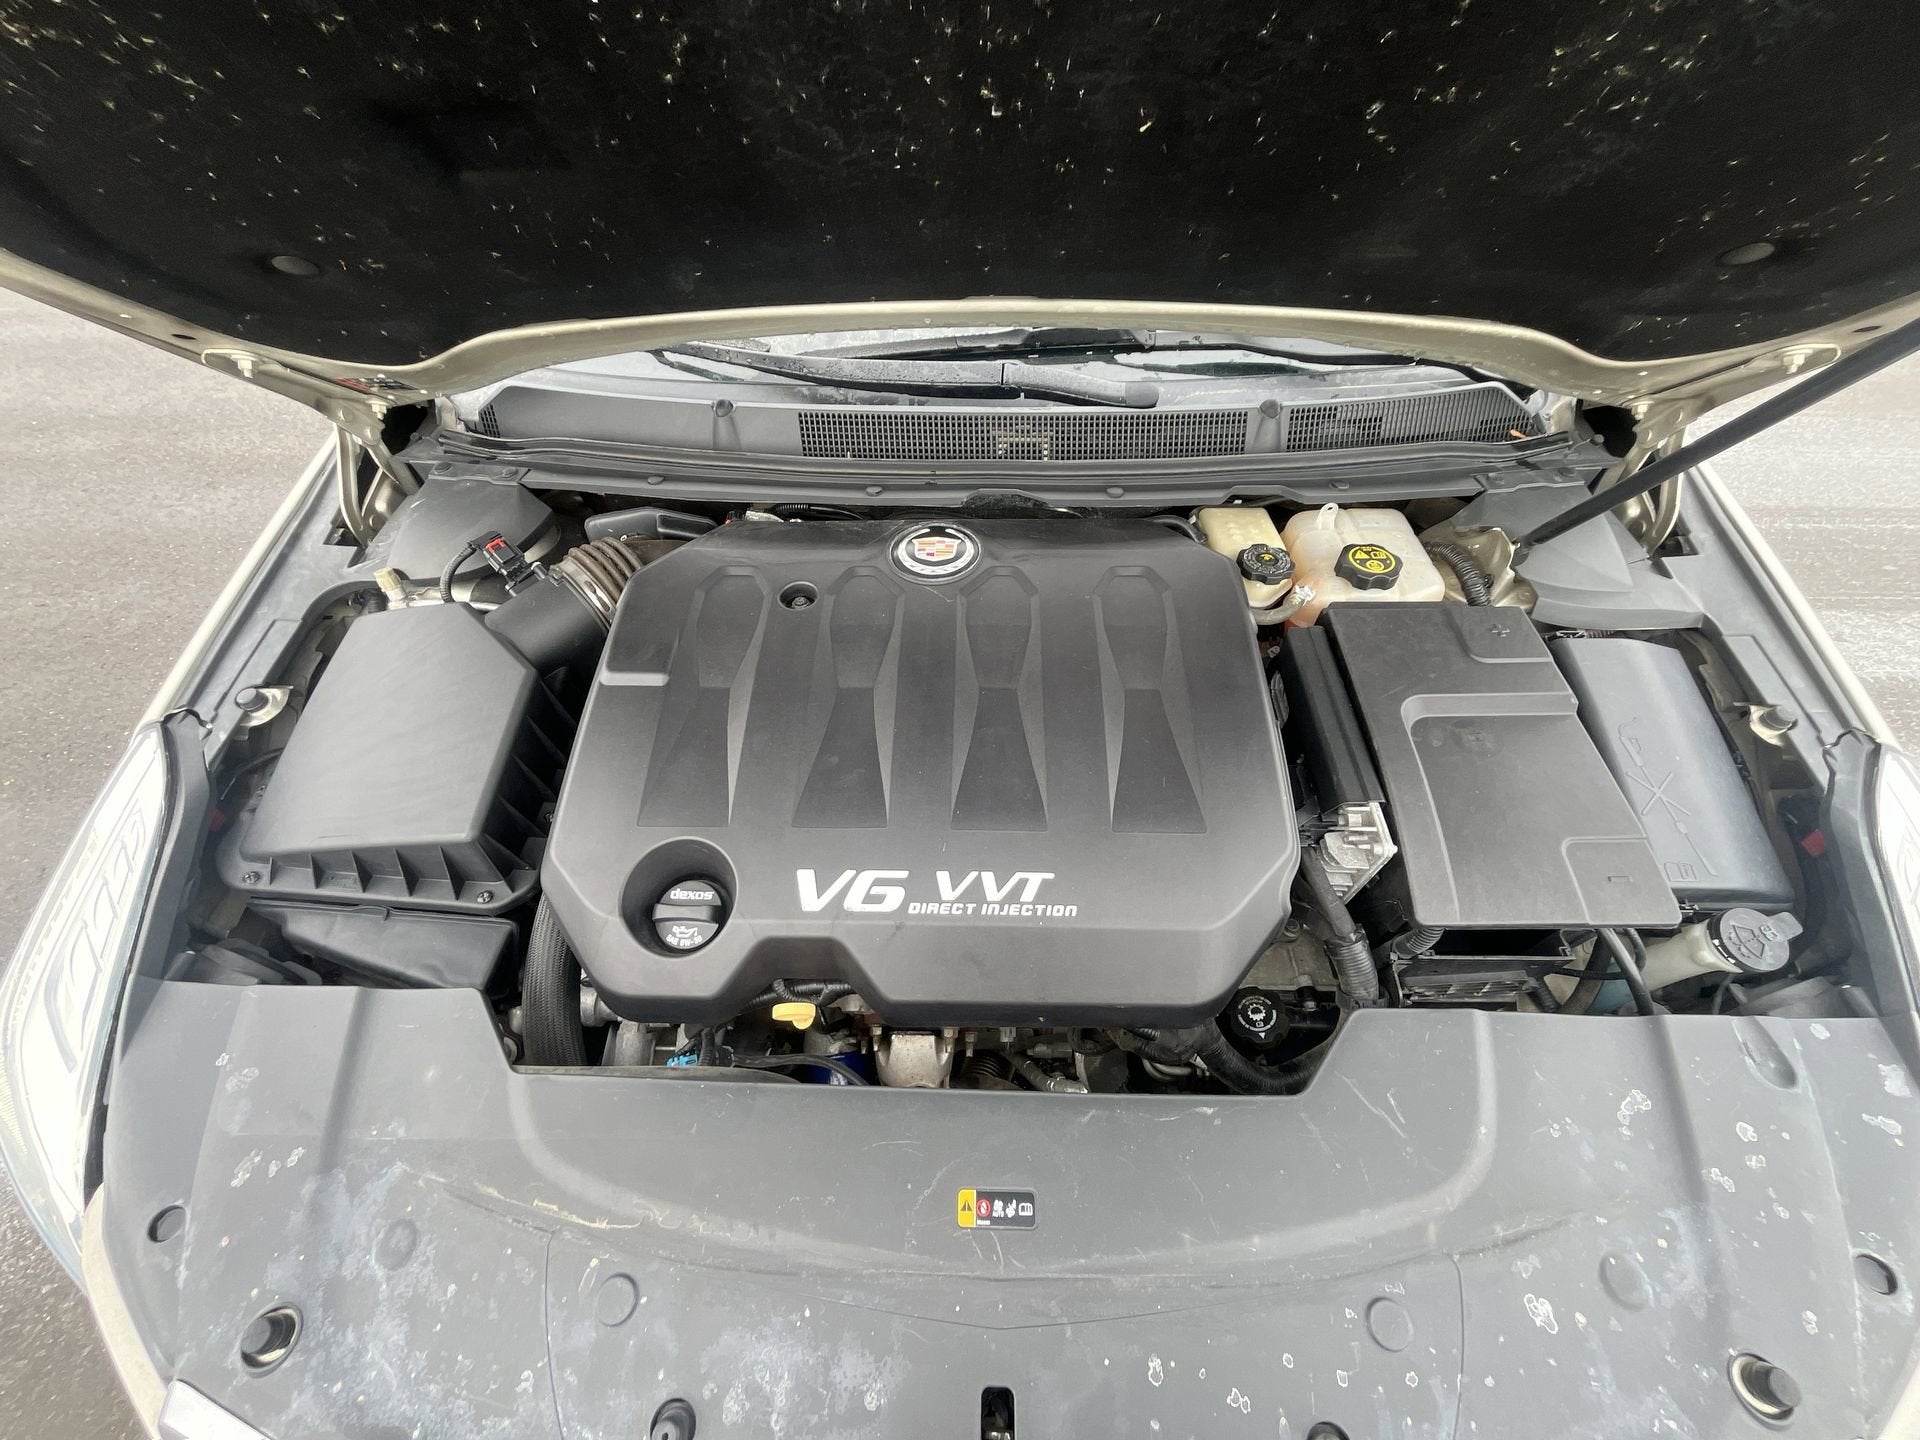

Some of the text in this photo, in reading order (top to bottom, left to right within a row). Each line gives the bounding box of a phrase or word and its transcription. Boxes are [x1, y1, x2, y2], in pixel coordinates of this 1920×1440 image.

[670, 888, 715, 900] dexos
[796, 868, 1055, 912] V6 VVT
[907, 902, 1078, 917] DIRECT INJECTION
